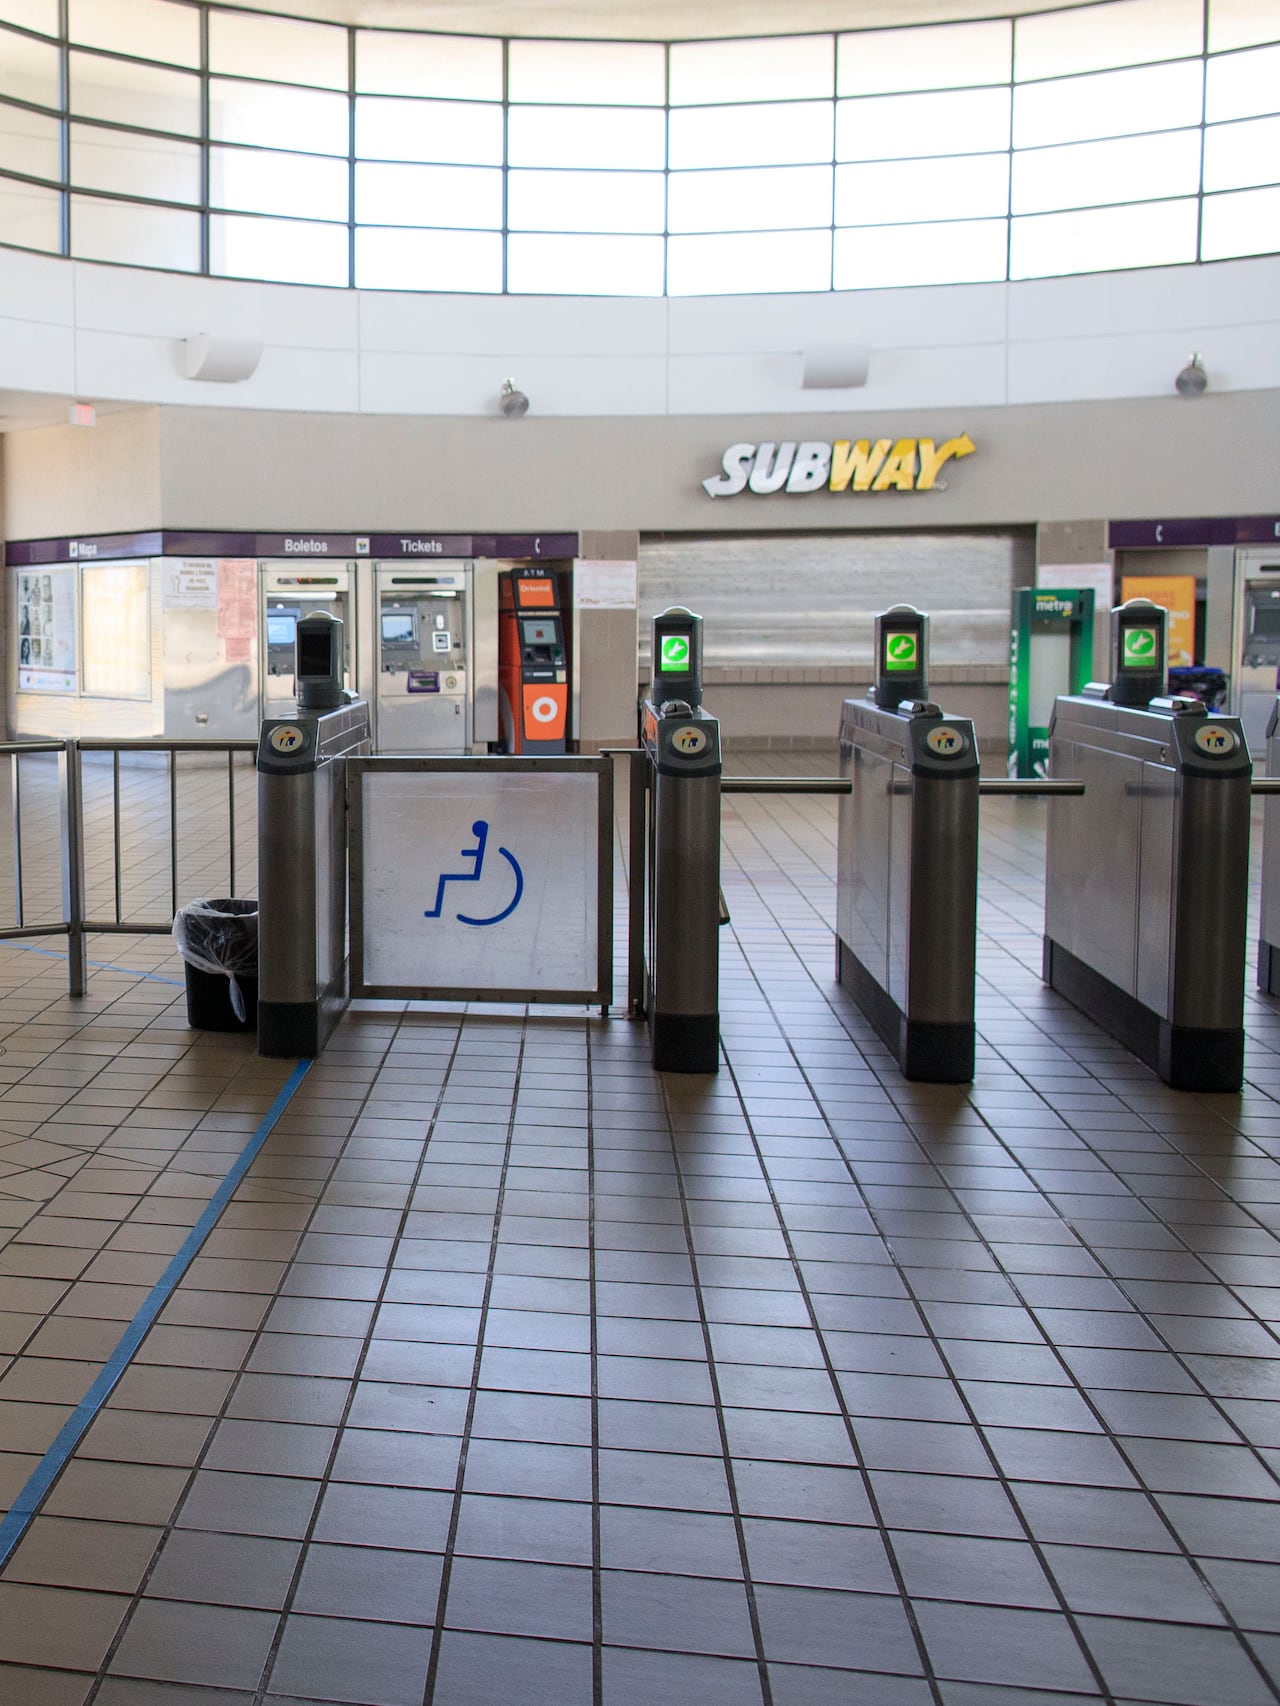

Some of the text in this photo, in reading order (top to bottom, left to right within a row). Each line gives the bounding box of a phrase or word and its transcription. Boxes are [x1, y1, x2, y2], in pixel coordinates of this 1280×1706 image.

[702, 432, 976, 499] SUBWAY
[284, 538, 328, 553] Boletos
[400, 539, 443, 553] Tickets
[1036, 600, 1073, 611] metro
